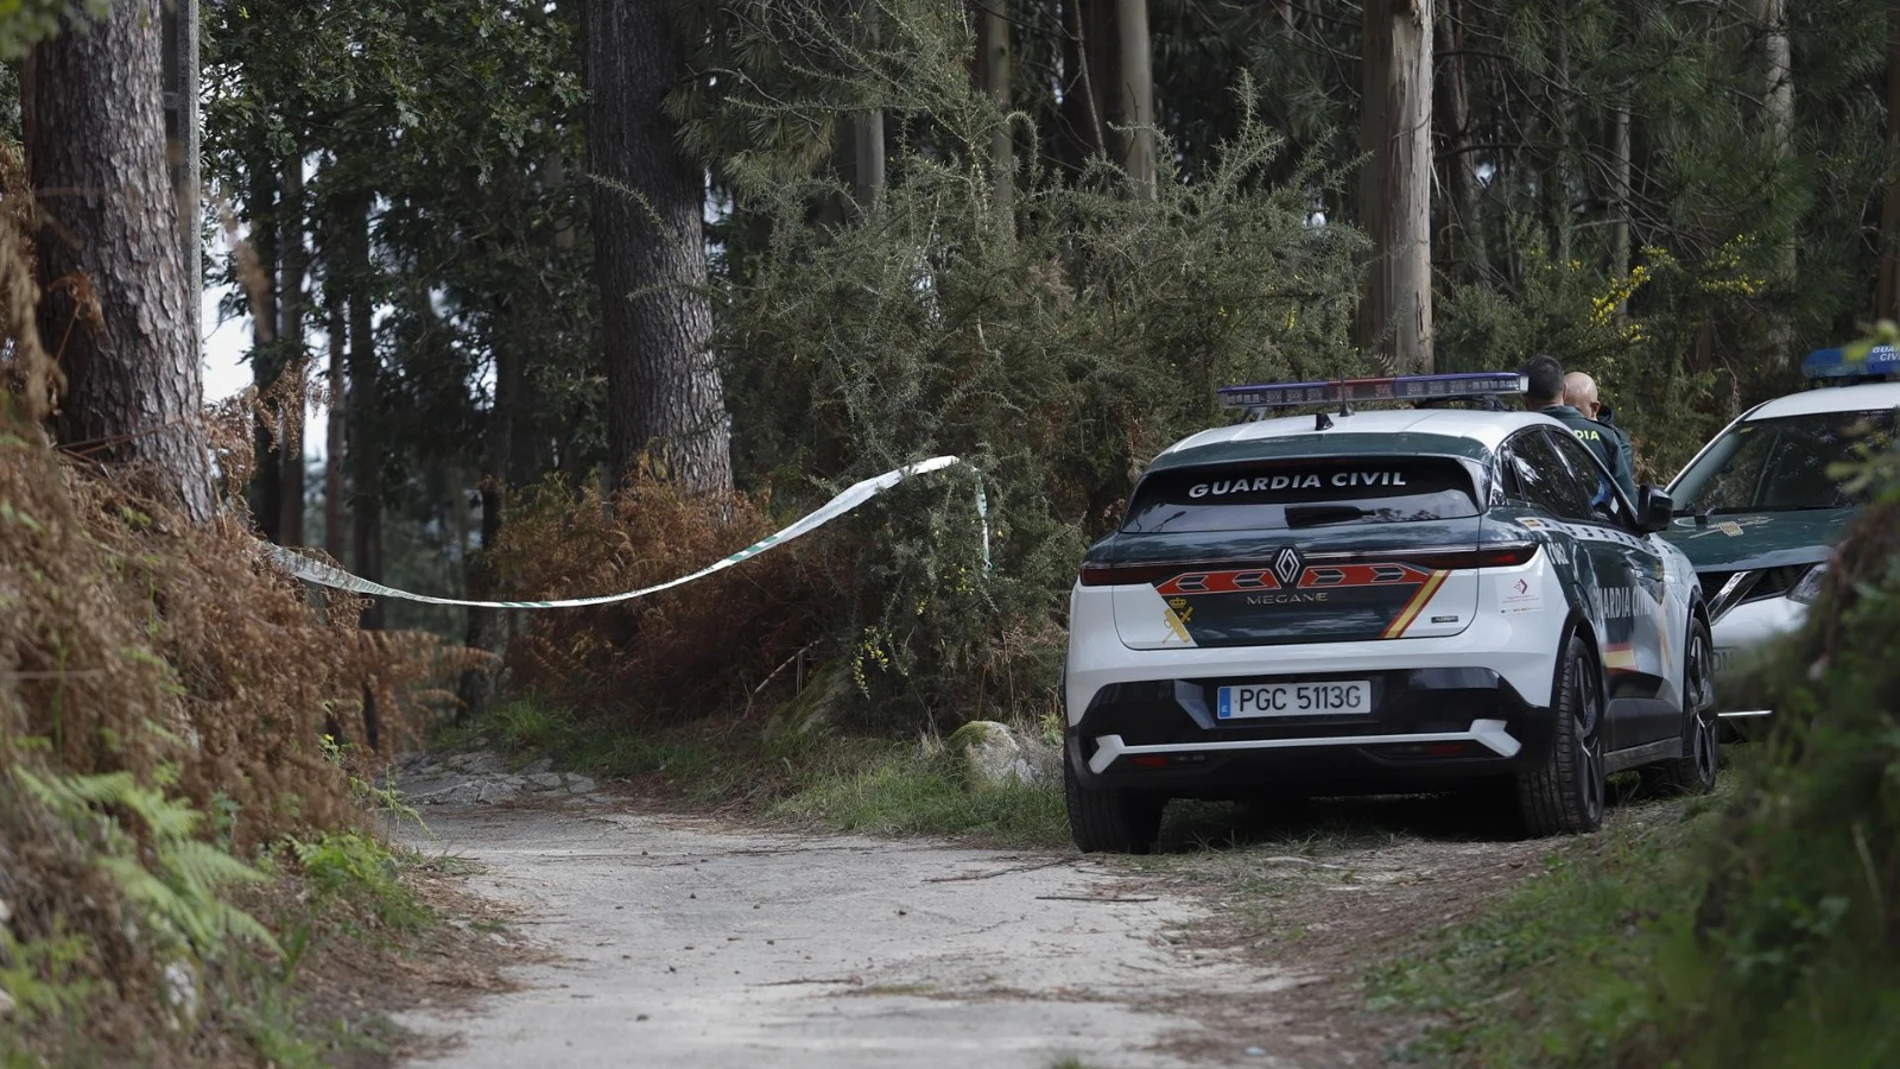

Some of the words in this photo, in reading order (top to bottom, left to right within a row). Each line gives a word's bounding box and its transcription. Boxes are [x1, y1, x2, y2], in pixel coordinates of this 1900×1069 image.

[1189, 474, 1321, 498] GUARDIA
[1331, 472, 1406, 486] CIVIL
[1247, 592, 1328, 605] MEGANE
[1239, 688, 1287, 712] PGC
[1296, 685, 1361, 710] 5113G
